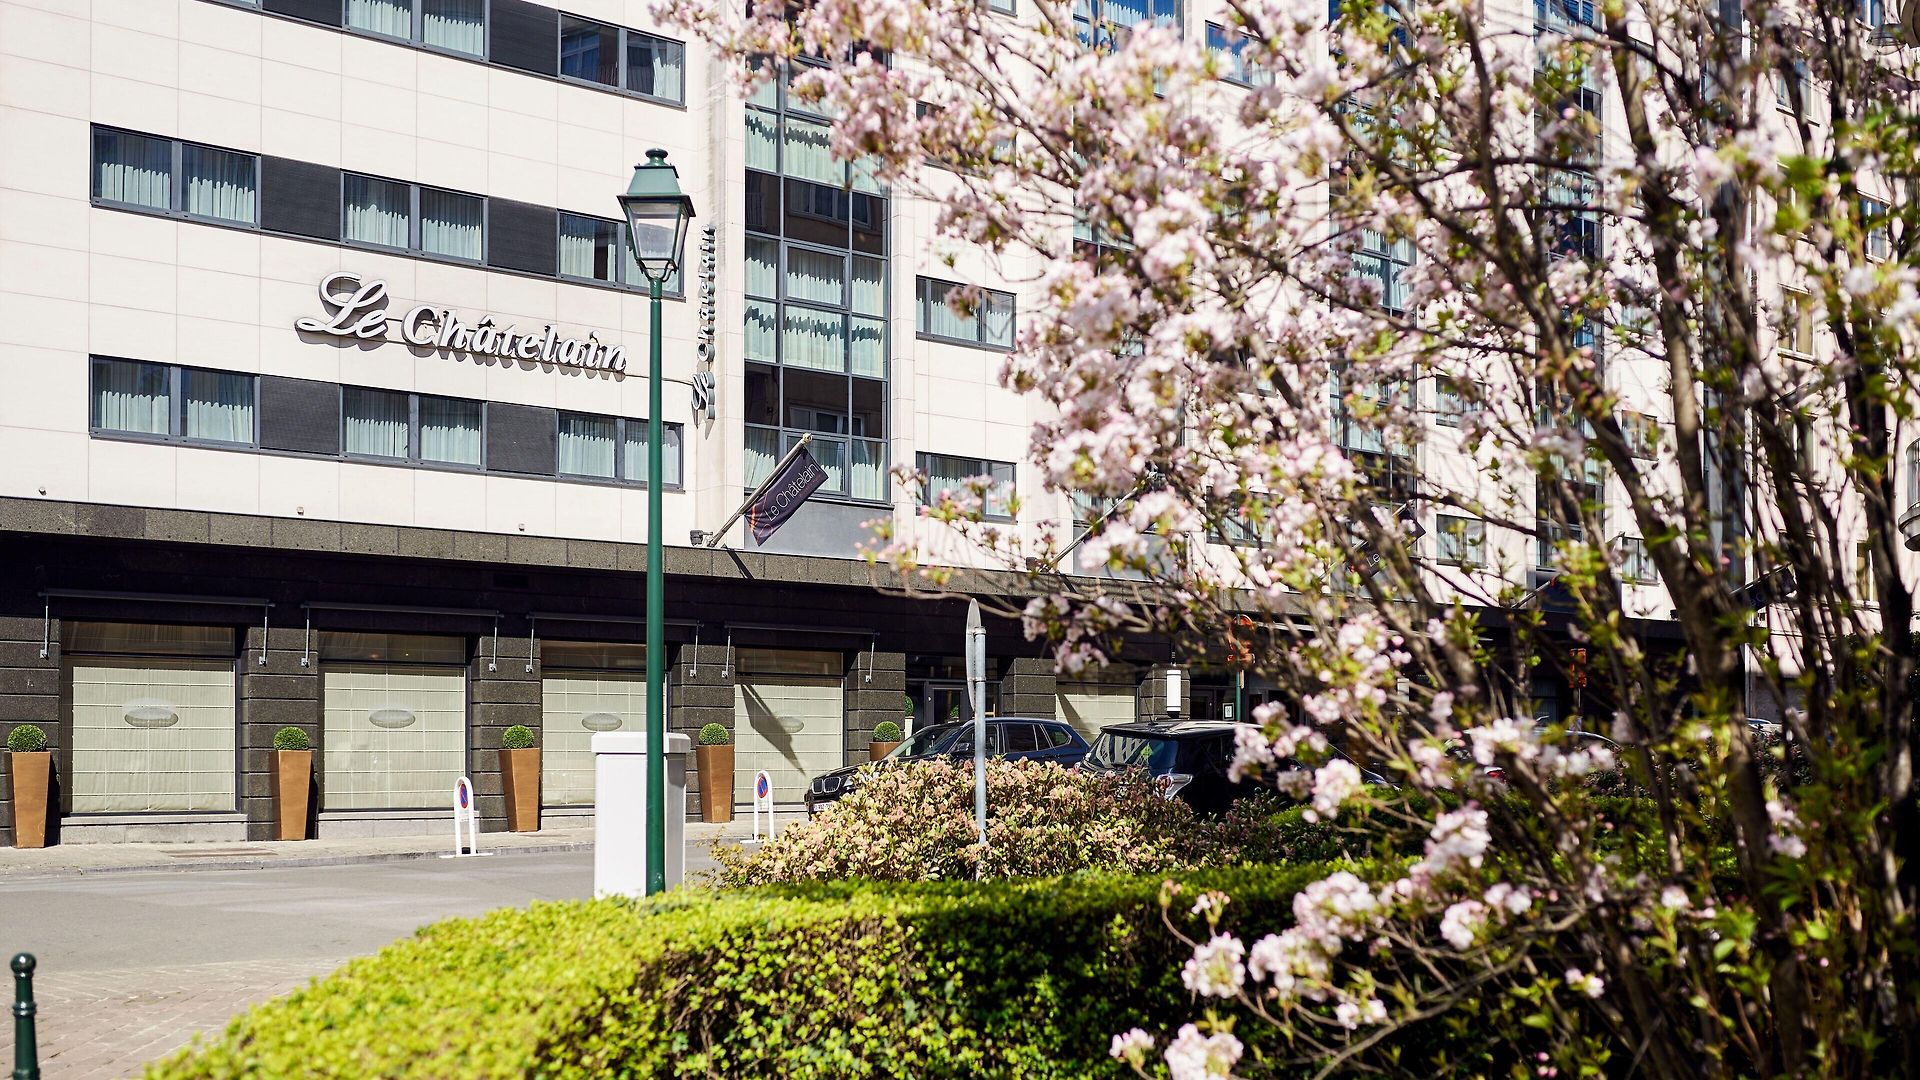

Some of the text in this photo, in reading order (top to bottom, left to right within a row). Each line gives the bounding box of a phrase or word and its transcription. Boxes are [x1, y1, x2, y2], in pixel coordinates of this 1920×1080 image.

[295, 271, 627, 371] Le Châtelain
[764, 505, 780, 522] Le
[775, 463, 819, 508] Châtelain
[1366, 553, 1381, 568] Le
